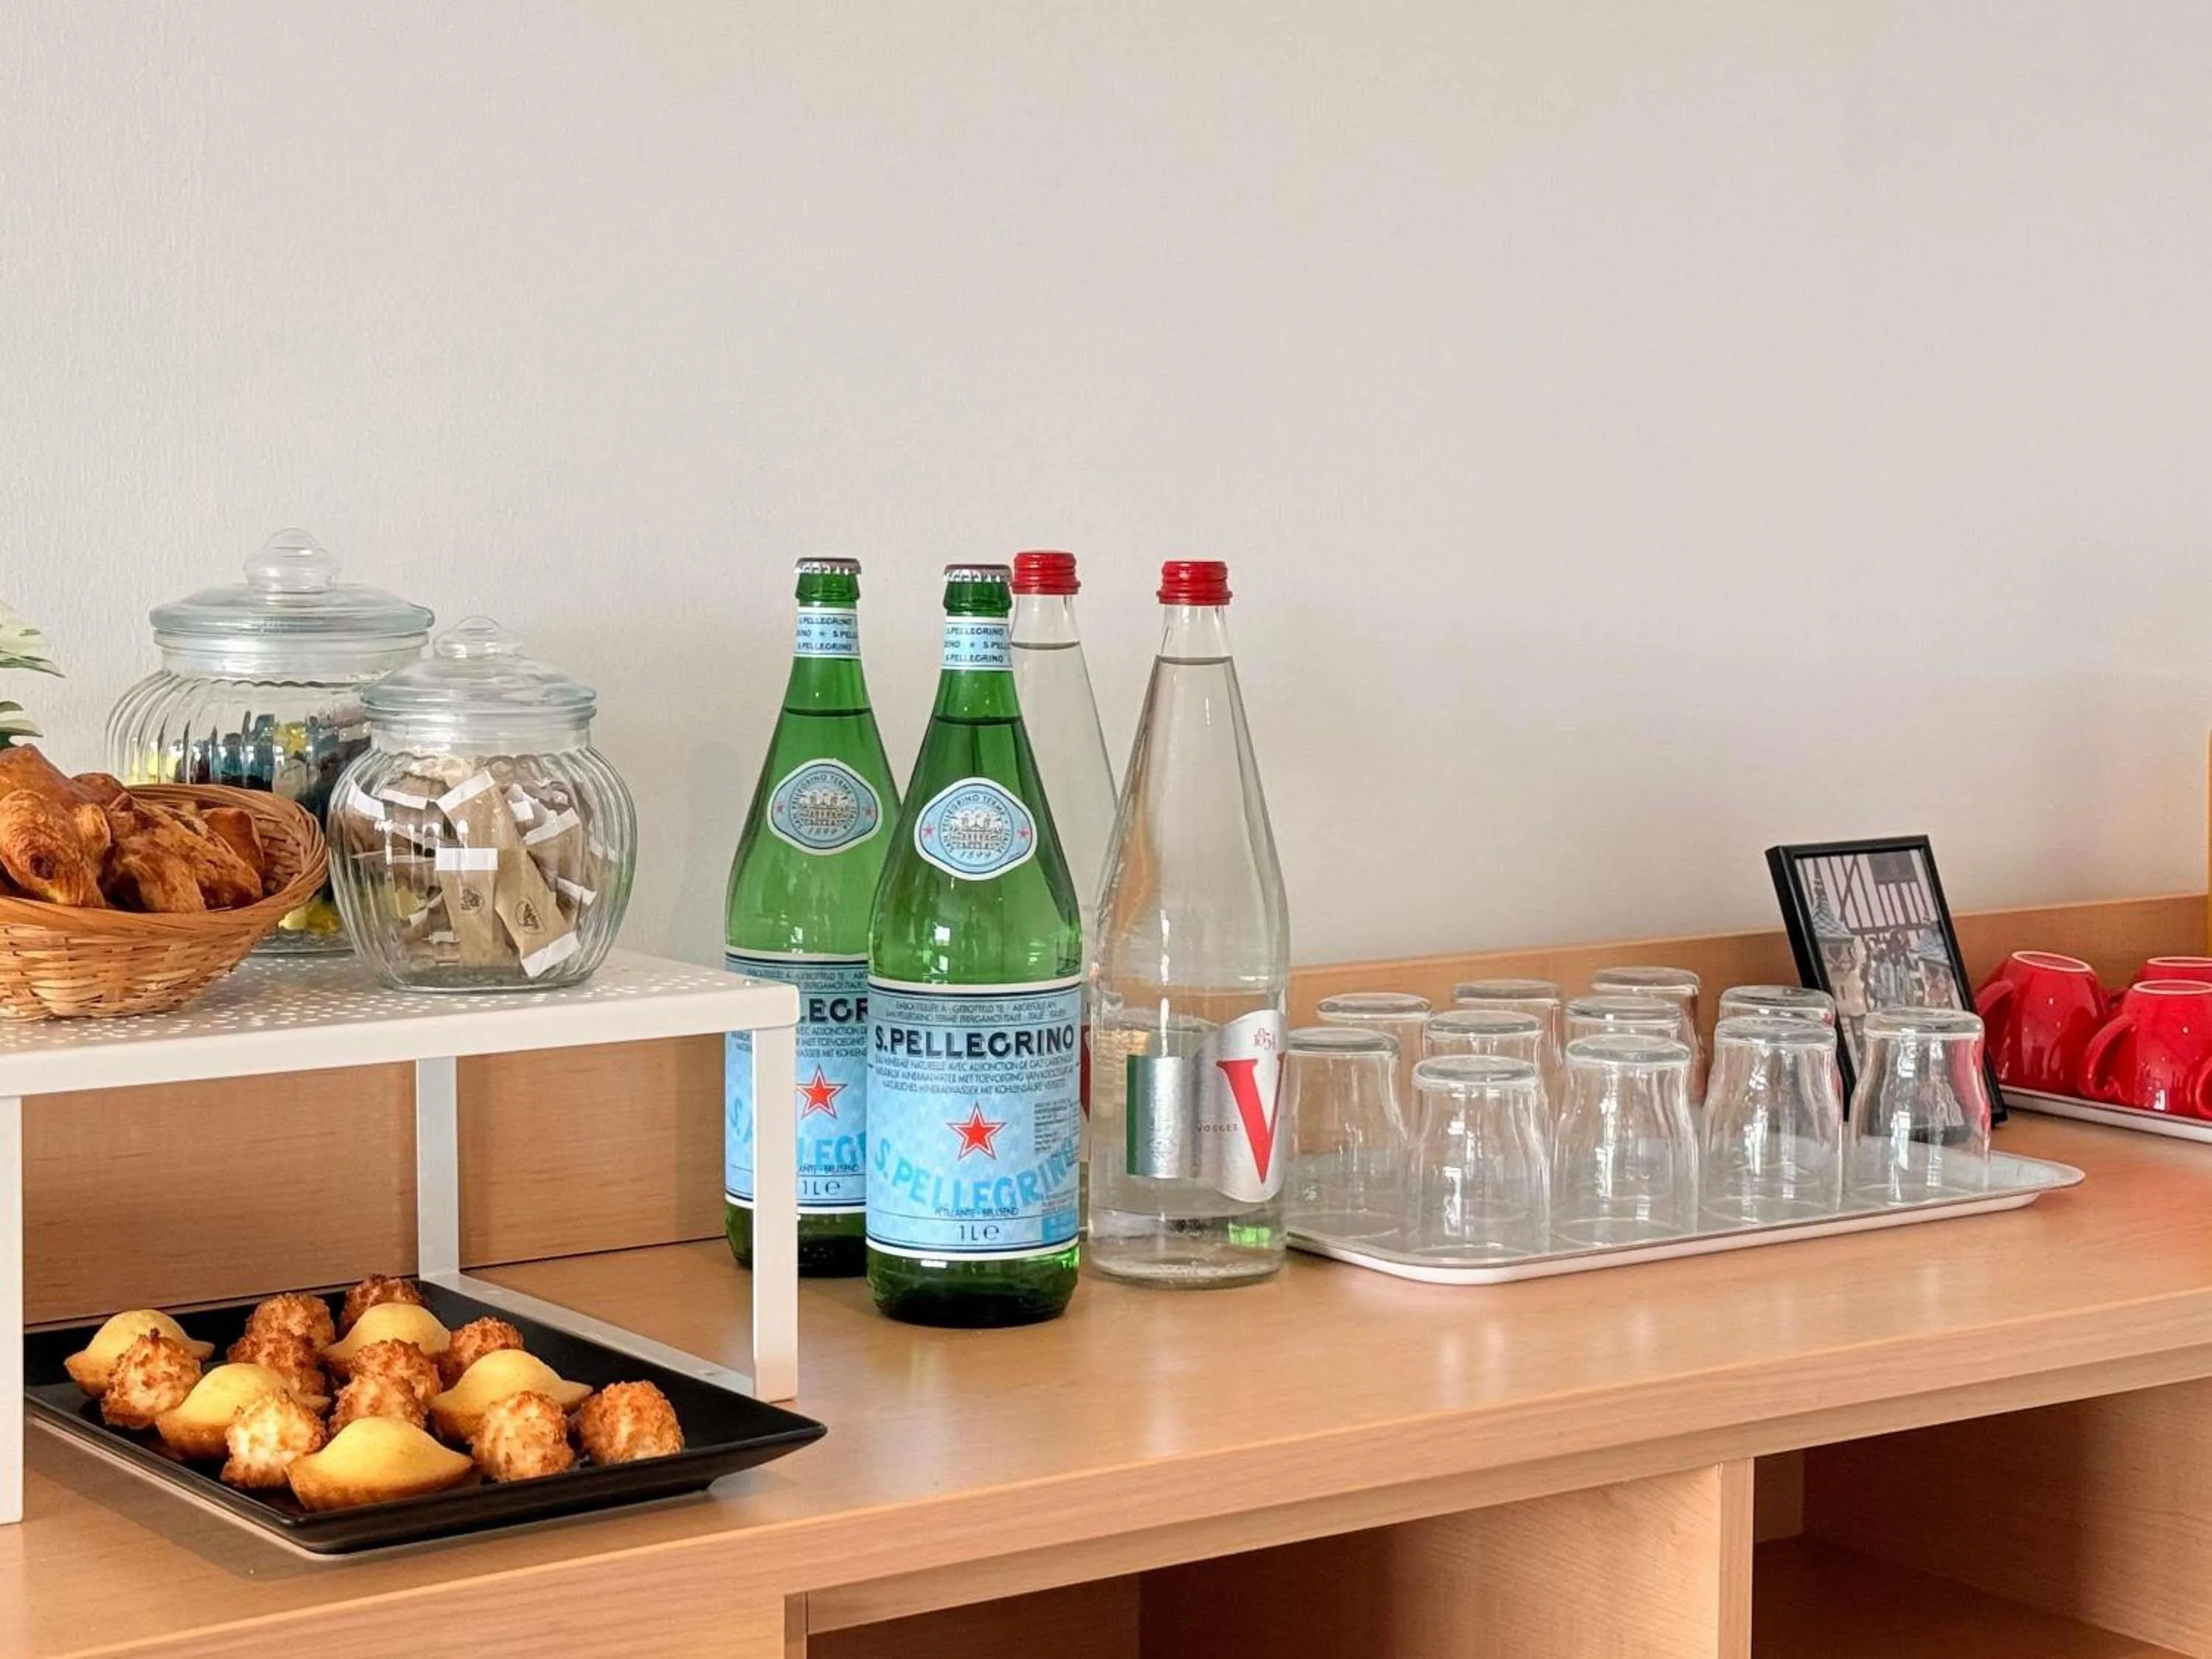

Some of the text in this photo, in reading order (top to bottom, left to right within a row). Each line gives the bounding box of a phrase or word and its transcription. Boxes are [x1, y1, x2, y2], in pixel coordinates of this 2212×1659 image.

[875, 1024, 1074, 1057] S.PELLEGRINO
[1195, 1123, 1238, 1133] VOSGES
[1216, 1051, 1286, 1185] V
